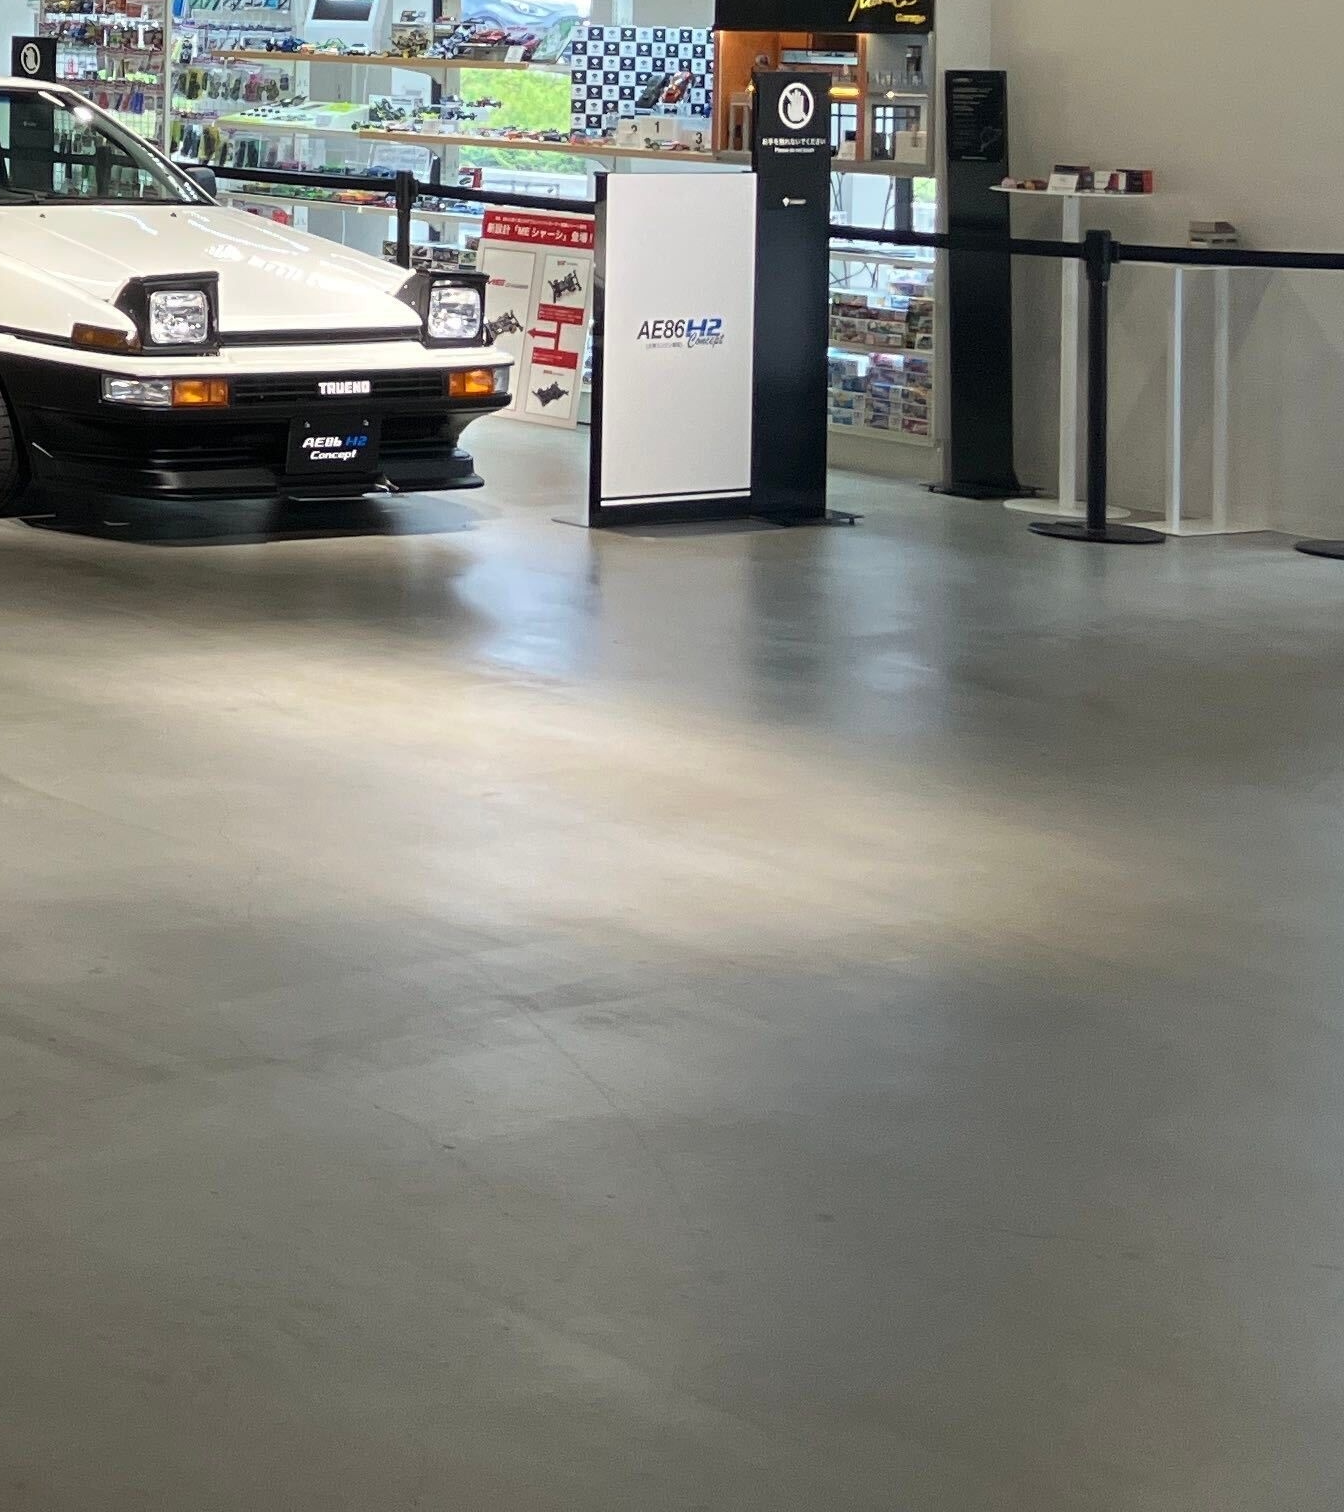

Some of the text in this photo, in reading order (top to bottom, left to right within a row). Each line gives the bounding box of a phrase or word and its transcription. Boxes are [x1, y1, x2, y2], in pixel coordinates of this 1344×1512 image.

[636, 318, 686, 340] AE86
[317, 379, 372, 395] TRUENO
[345, 434, 369, 447] H2
[309, 449, 358, 461] Concept
